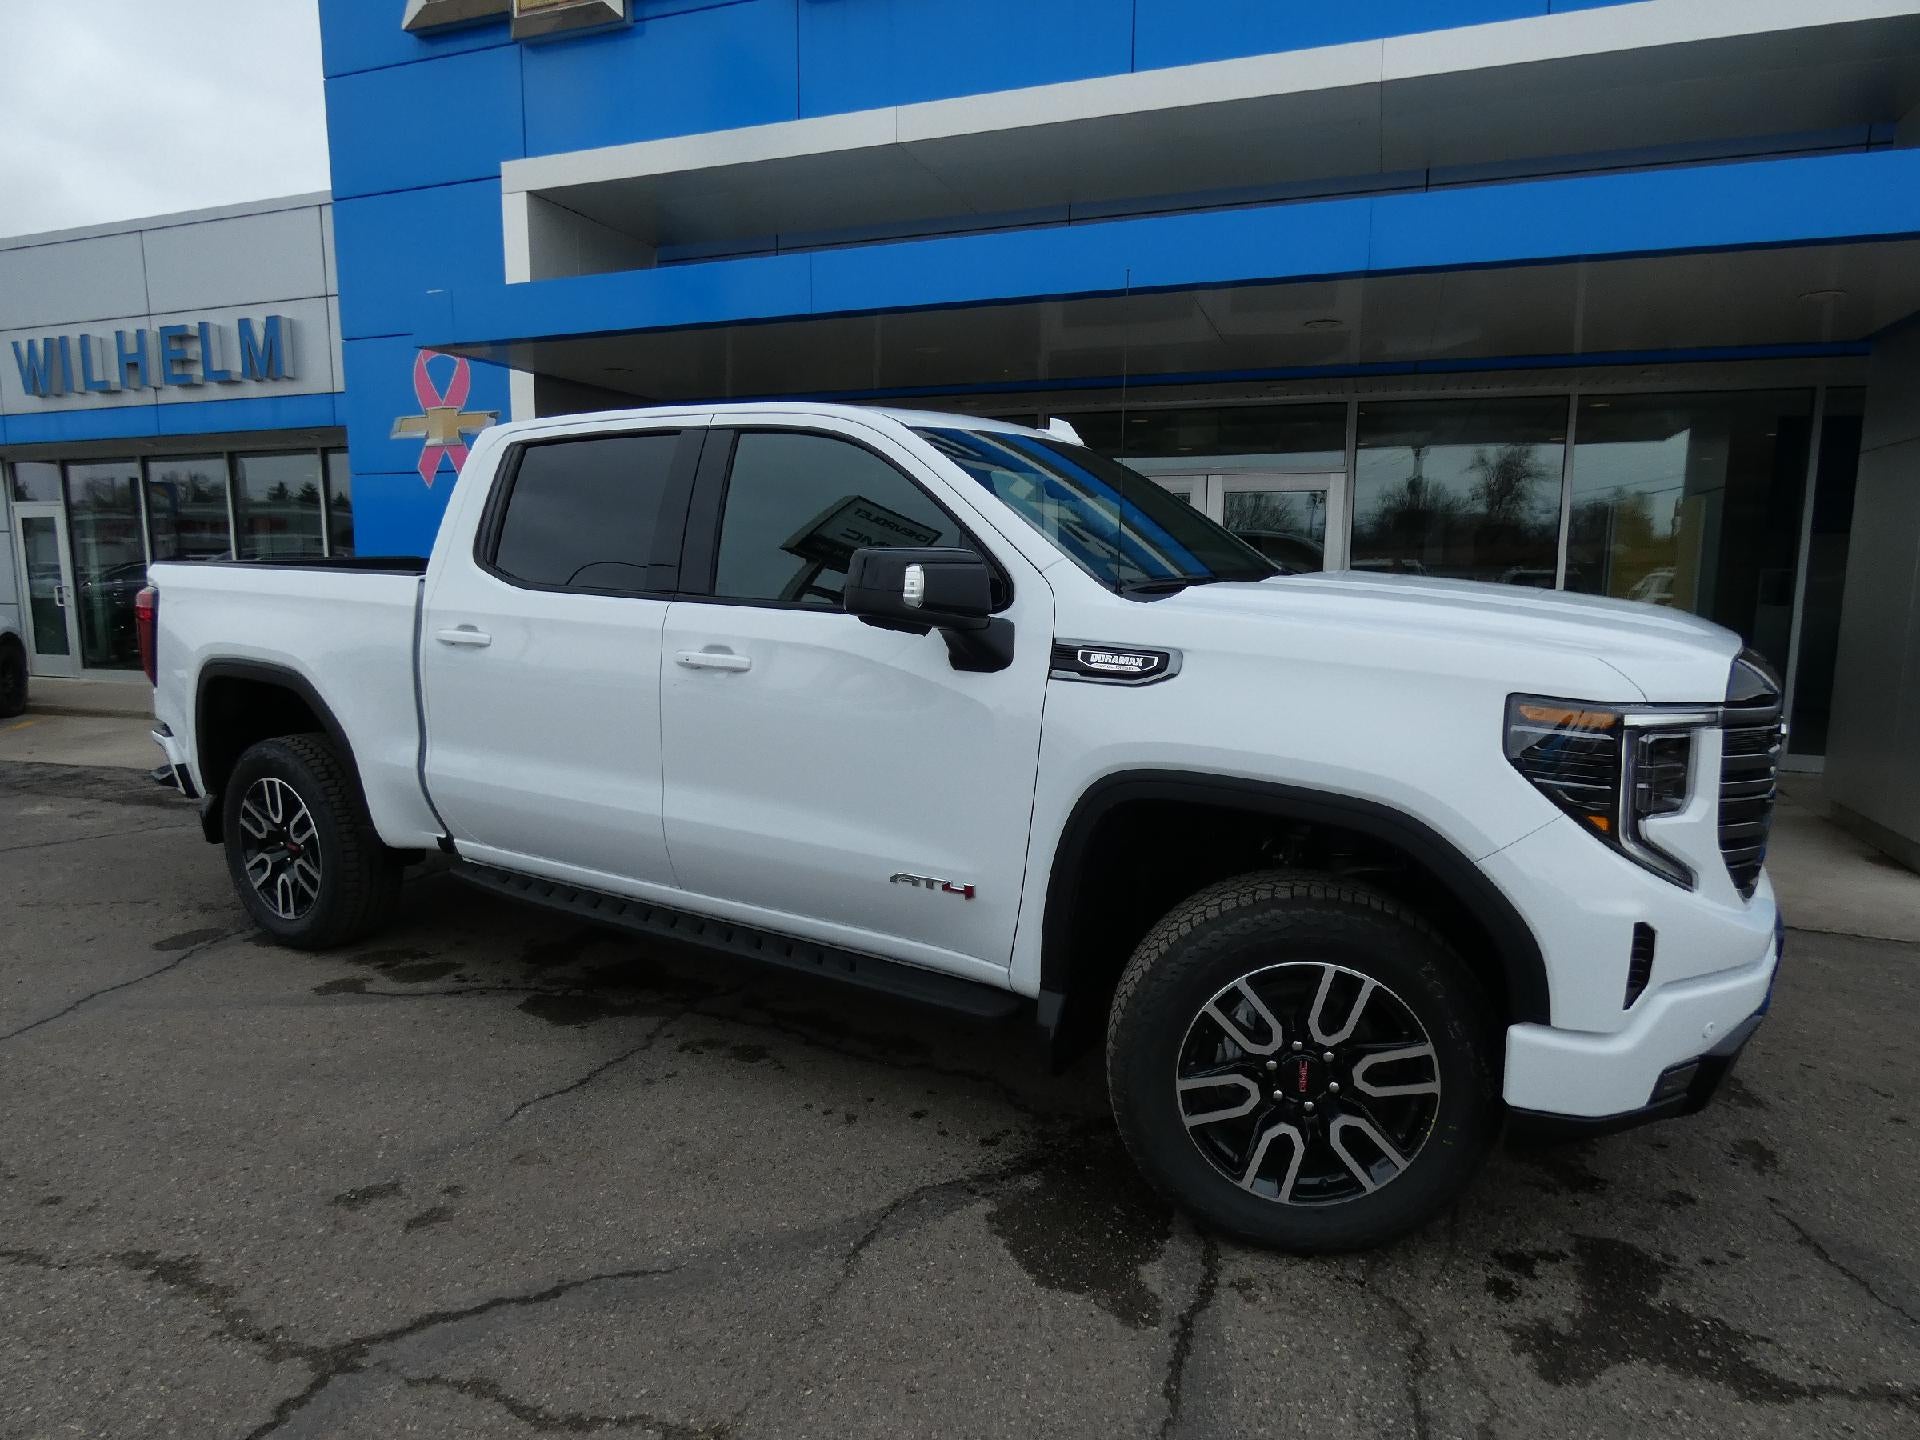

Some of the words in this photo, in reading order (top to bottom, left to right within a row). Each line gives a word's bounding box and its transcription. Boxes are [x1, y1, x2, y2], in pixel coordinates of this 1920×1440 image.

[12, 314, 289, 397] WILHELM
[1090, 653, 1143, 666] DURAMAX
[889, 872, 976, 900] AT4
